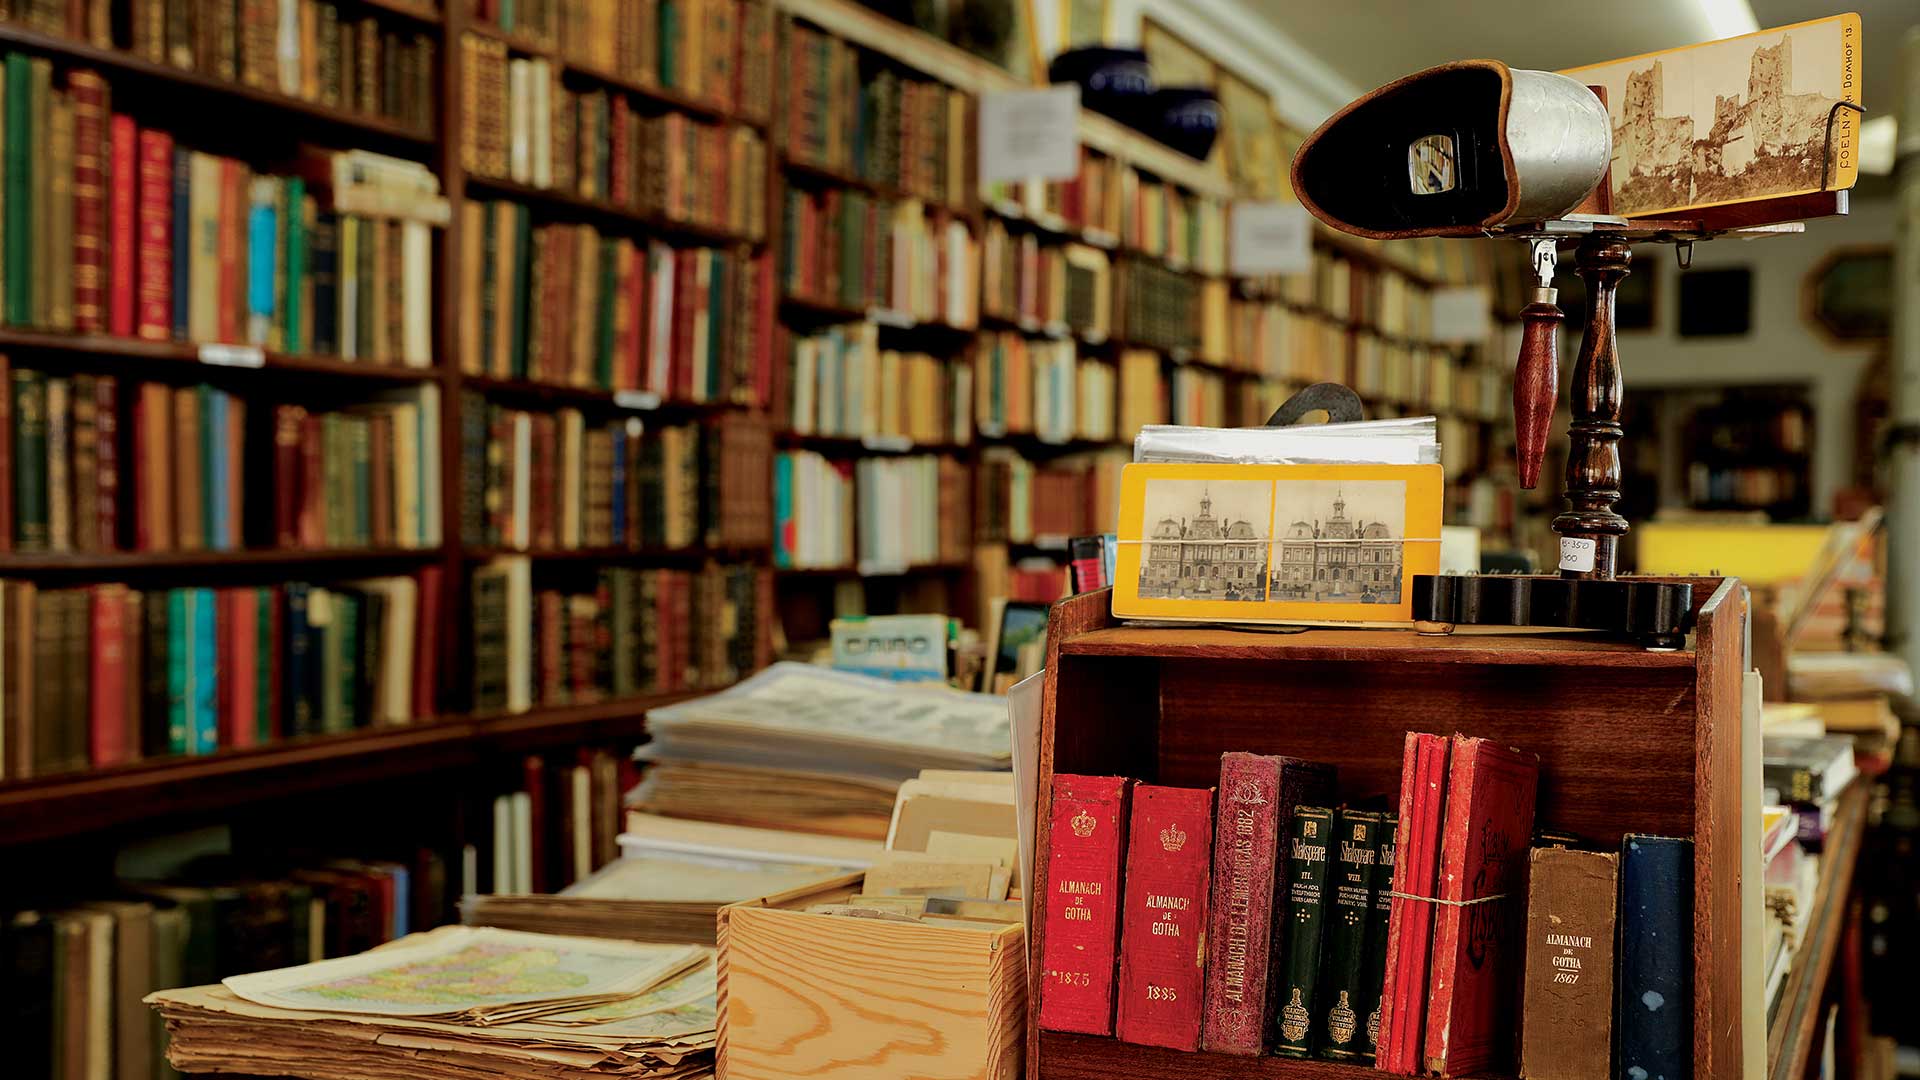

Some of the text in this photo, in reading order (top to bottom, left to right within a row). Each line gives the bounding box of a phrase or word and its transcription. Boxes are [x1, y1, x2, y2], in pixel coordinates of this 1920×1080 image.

[1843, 43, 1853, 89] DOMHOF
[1059, 880, 1102, 896] ALMANACH
[1075, 896, 1084, 905] DE
[1146, 895, 1190, 911] ALMANACH
[1225, 938, 1247, 1002] ALMANACH
[1236, 808, 1254, 836] 1882
[1065, 907, 1092, 921] GOTHA
[1163, 912, 1172, 920] DE
[1152, 923, 1180, 937] GOTHA
[1545, 934, 1592, 949] ALMANACH
[1552, 955, 1582, 969] GOTHA
[1058, 971, 1090, 986] 1875
[1553, 972, 1579, 985] 1861
[1146, 985, 1177, 1001] 1885
